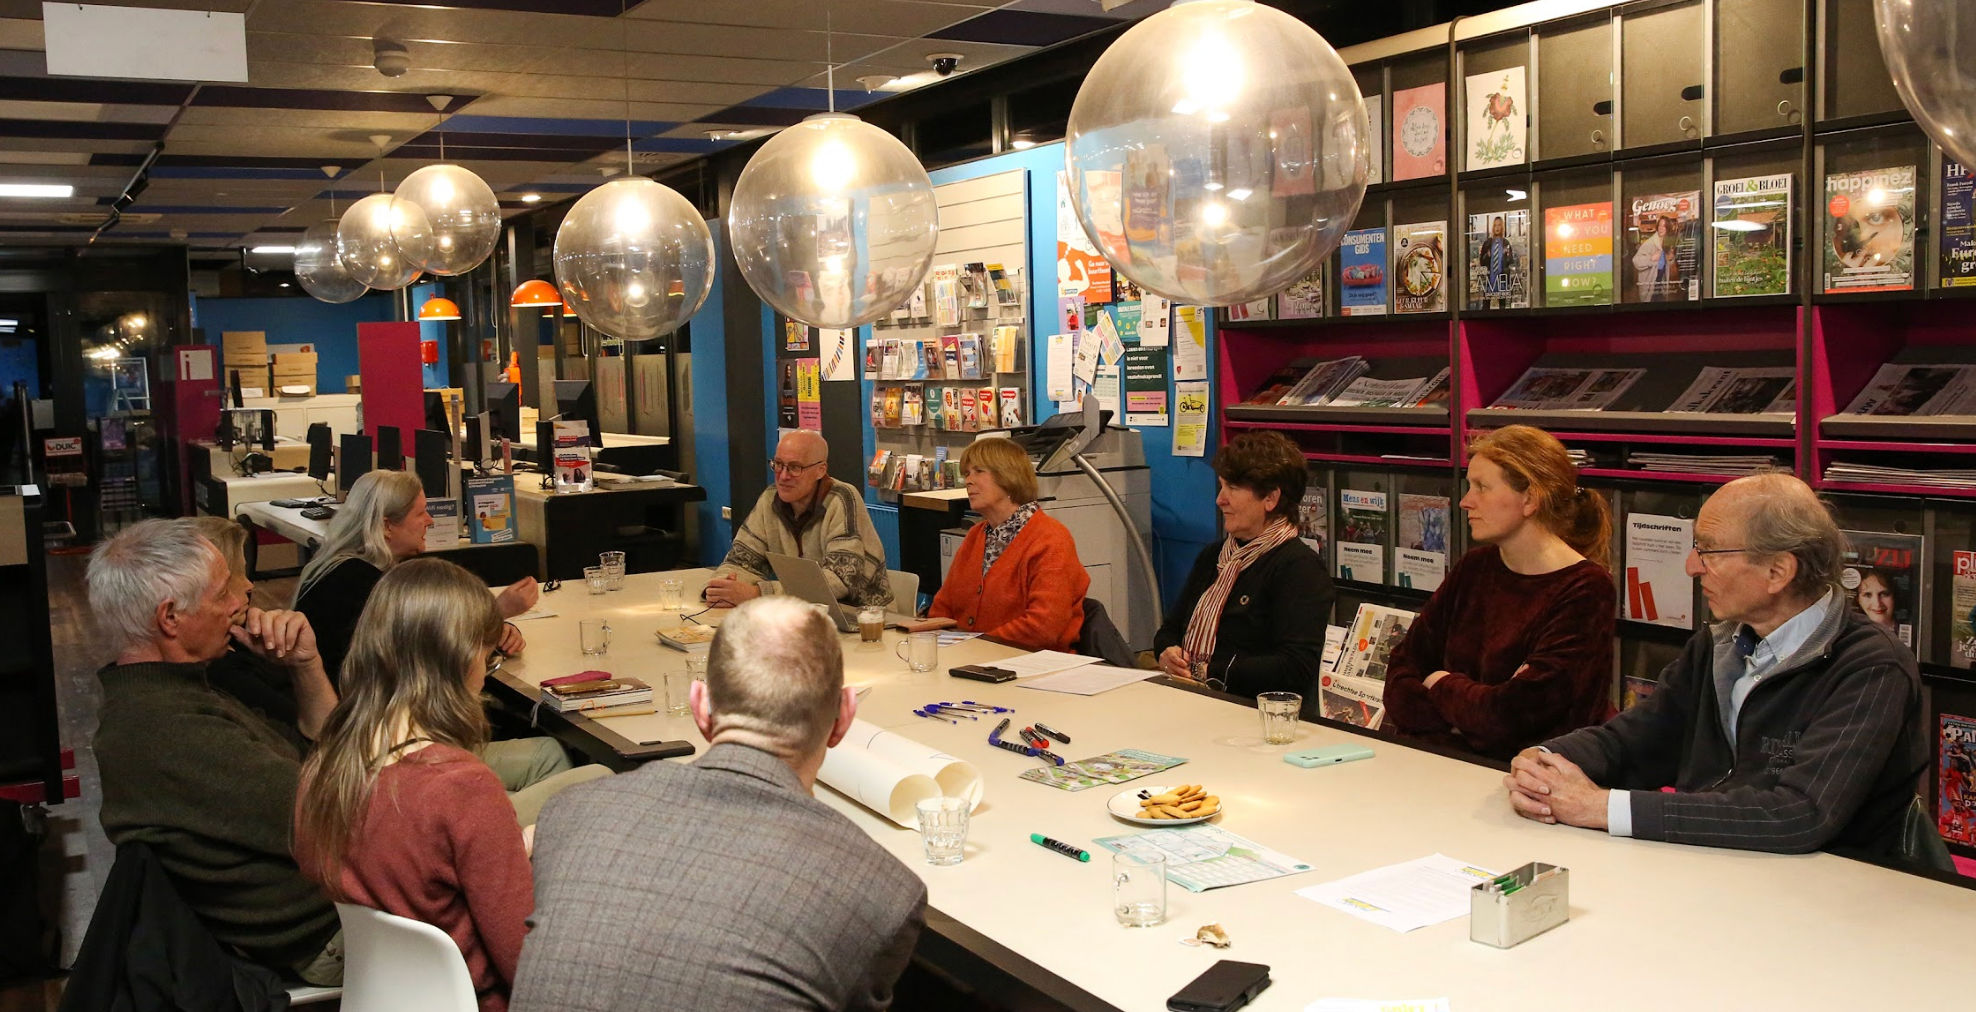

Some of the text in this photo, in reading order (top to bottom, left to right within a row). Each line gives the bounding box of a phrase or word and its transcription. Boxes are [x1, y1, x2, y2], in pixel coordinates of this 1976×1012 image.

[1717, 178, 1787, 195] GROEI & BLOEI
[1827, 171, 1913, 193] happinez
[1632, 198, 1677, 215] Genoeg
[1564, 209, 1595, 220] WHAT
[1584, 225, 1608, 235] YOU
[1340, 232, 1385, 246] CONSUMENTEN
[1354, 244, 1370, 254] GIDS
[1564, 243, 1593, 253] NEED
[1564, 259, 1597, 270] RIGHT
[1302, 494, 1323, 504] oren
[1343, 493, 1385, 507] Mens en wijk
[1632, 522, 1682, 533] Tijdschriften
[1402, 553, 1434, 564] Neem mee
[1332, 679, 1358, 696] Utrechtse
